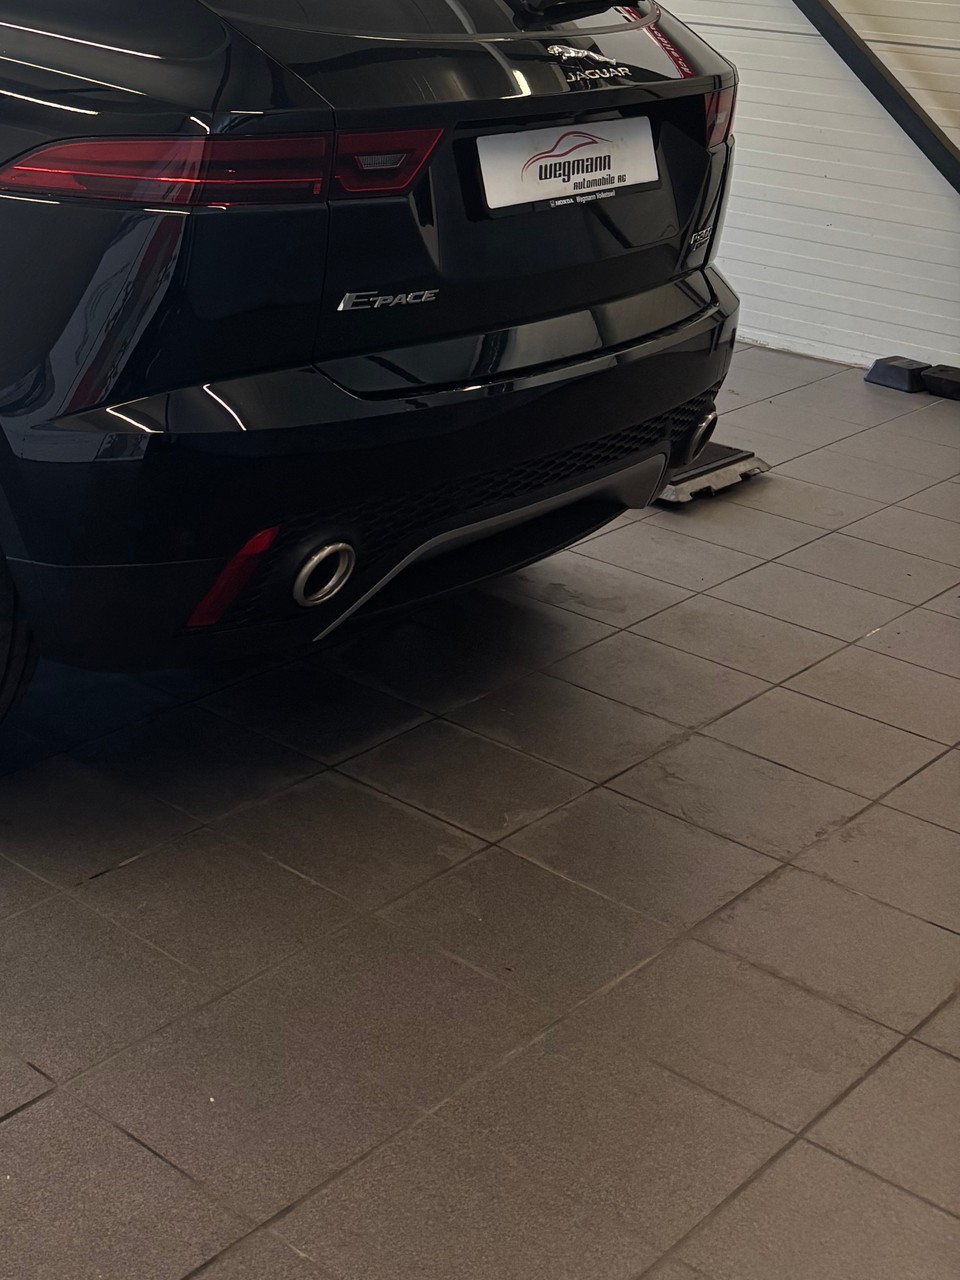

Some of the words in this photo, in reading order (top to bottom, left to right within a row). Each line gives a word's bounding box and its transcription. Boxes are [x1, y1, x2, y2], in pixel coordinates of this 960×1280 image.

[566, 67, 632, 83] JAGUAR
[538, 154, 611, 183] wegmann
[573, 174, 616, 191] automobile
